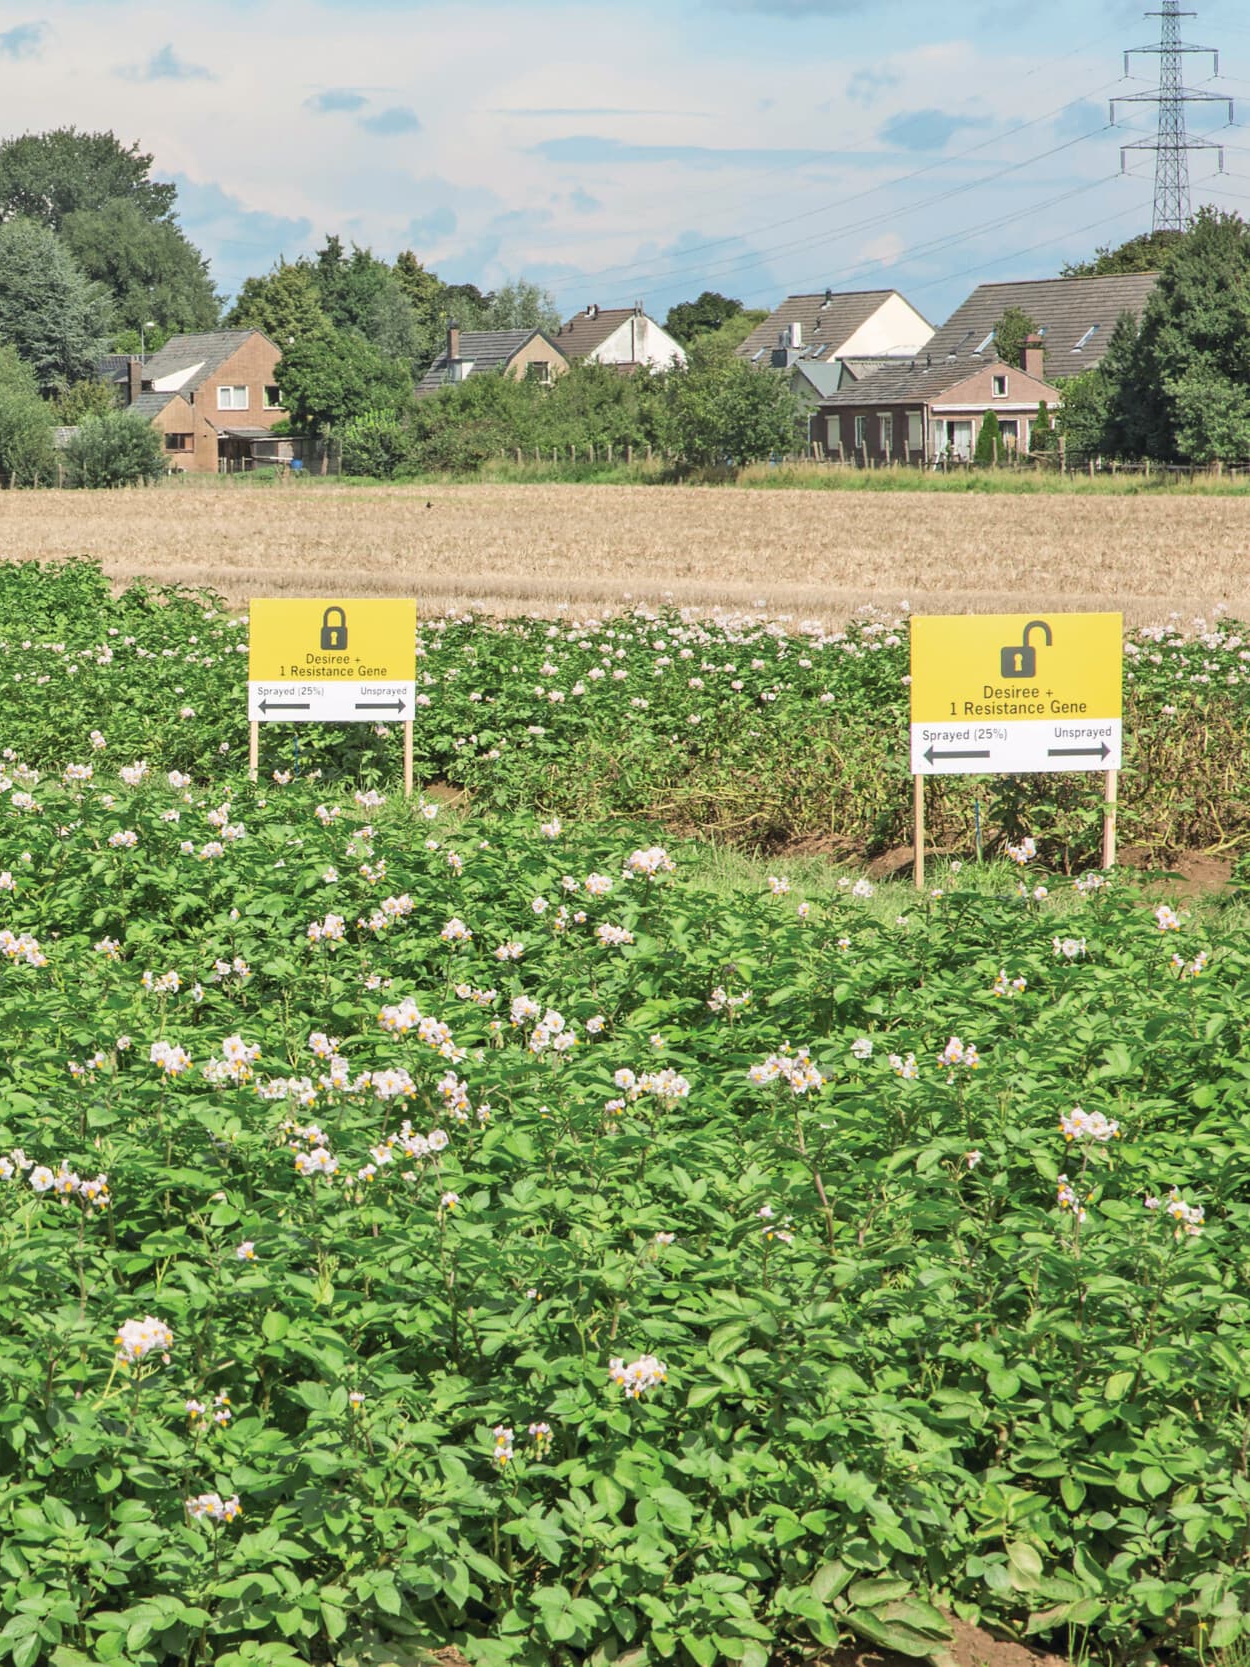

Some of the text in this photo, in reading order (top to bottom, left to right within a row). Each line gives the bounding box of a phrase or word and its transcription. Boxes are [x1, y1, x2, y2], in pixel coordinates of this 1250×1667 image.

[306, 653, 350, 664] Desiree
[280, 665, 387, 677] 1 Resistance Gene
[257, 686, 324, 696] Sprayed (25%)
[360, 686, 407, 696] Unsprayed
[983, 685, 1040, 699] Desiree
[950, 700, 1087, 715] 1 Resistance Gene
[922, 728, 1008, 742] Sprayed (25%)
[1054, 726, 1112, 739] Unsprayed
